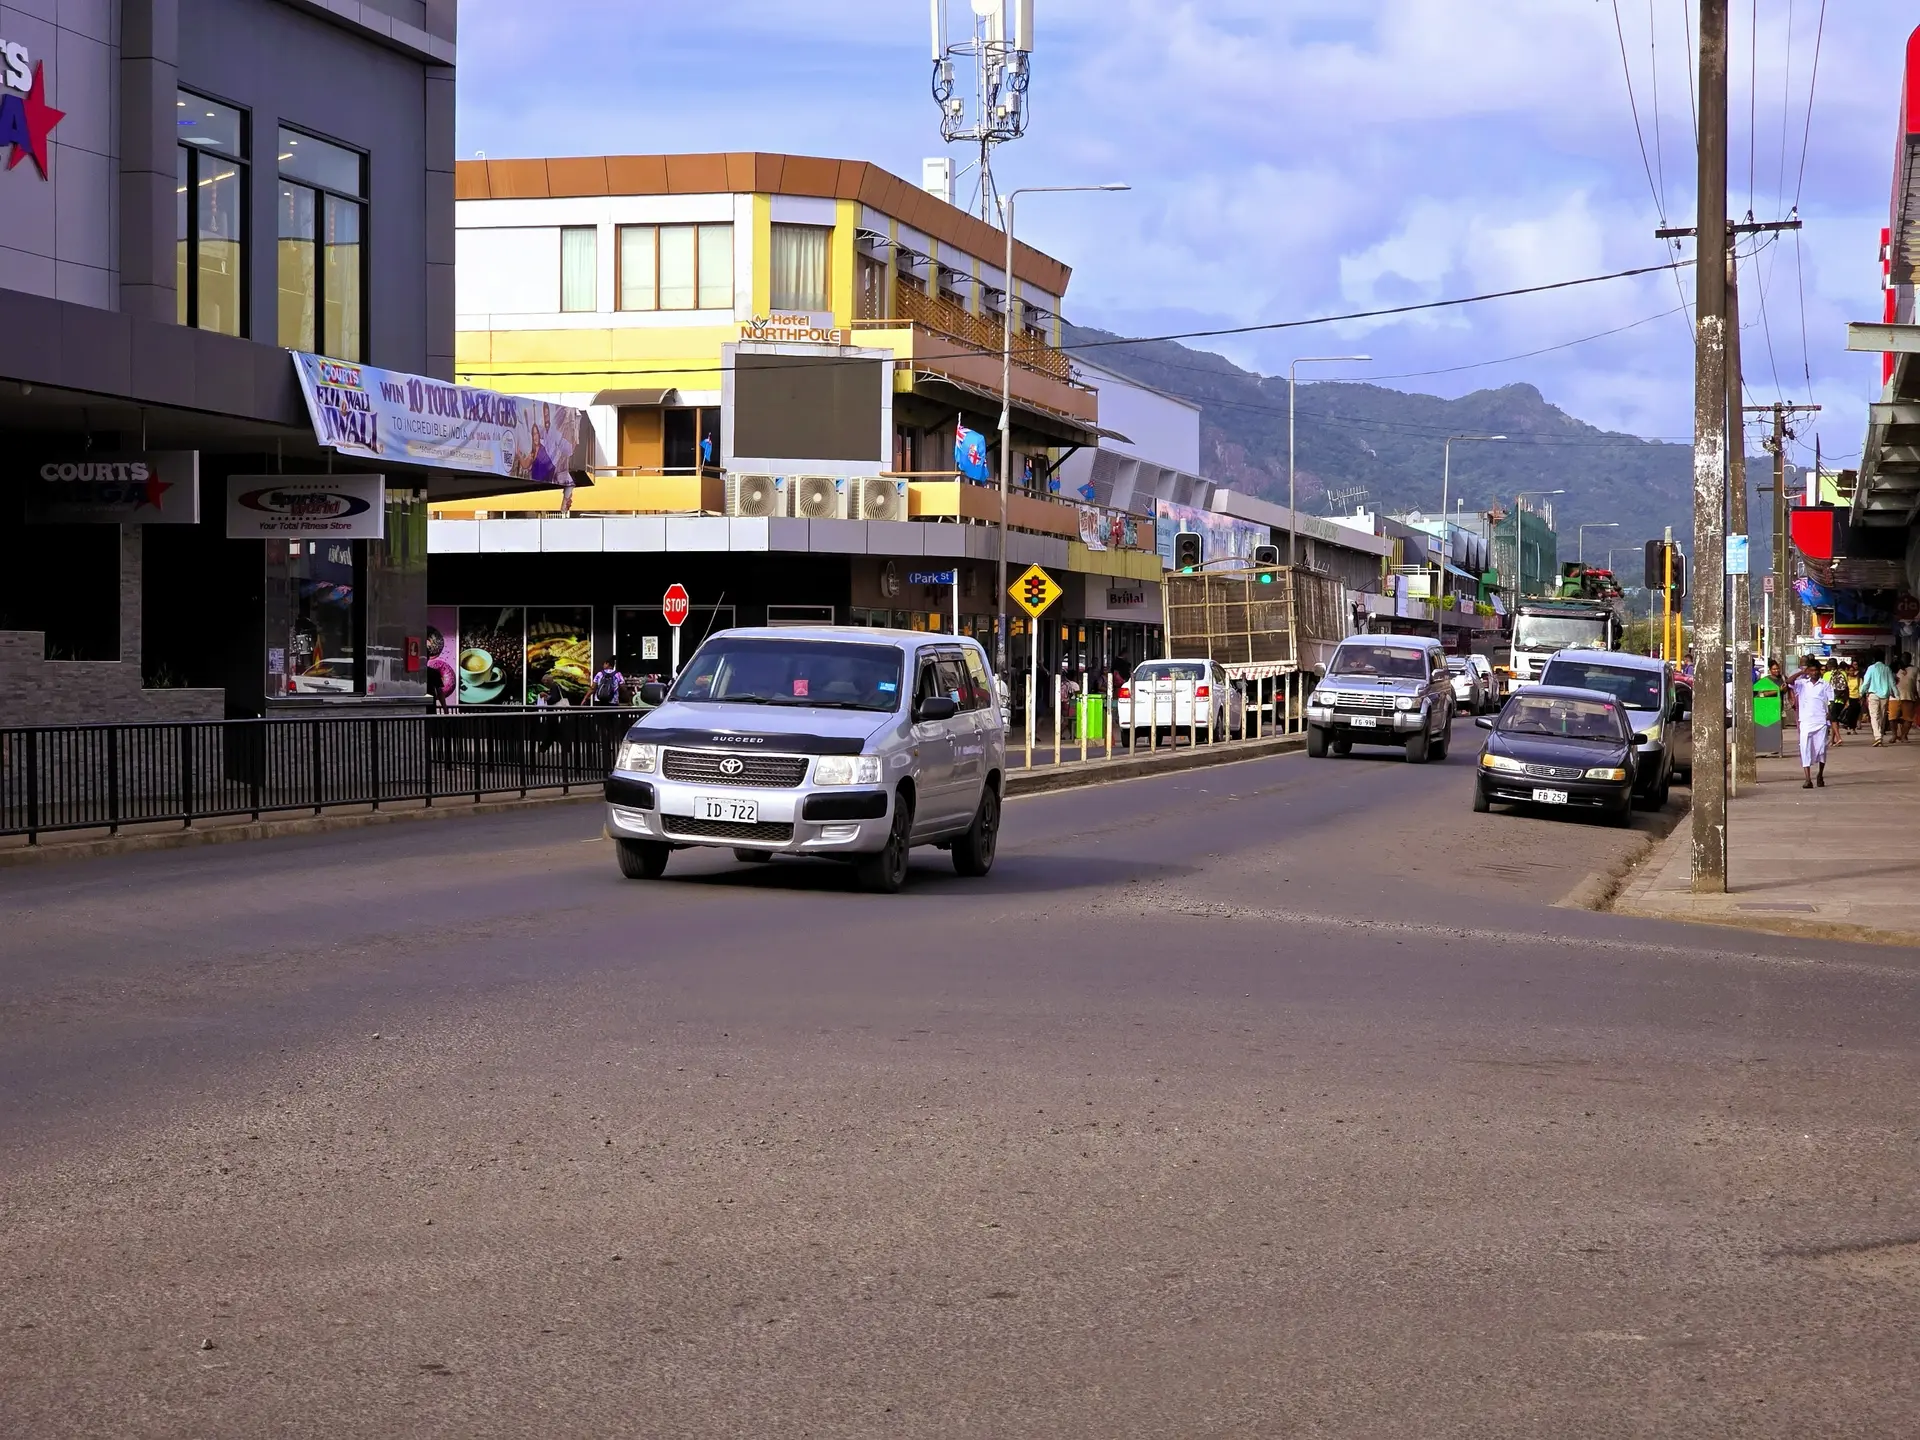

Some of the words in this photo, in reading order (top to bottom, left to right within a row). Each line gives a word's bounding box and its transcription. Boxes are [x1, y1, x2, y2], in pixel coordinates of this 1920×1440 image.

[771, 315, 810, 326] Hotel
[741, 326, 840, 342] NORTHPOLE
[322, 365, 360, 385] COURTS
[344, 390, 371, 412] WALI
[380, 382, 405, 404] WIN
[407, 378, 423, 414] 10
[425, 384, 460, 419] TOUR
[461, 390, 518, 429] PACKAGES
[392, 416, 403, 431] TO
[404, 418, 447, 438] INCREDIBLE
[448, 425, 468, 440] INDIA
[40, 462, 149, 482] COURTS
[269, 492, 328, 508] Sports
[290, 501, 341, 516] World
[259, 522, 277, 530] Your
[280, 522, 299, 530] Total
[301, 522, 329, 530] Fitness
[330, 522, 352, 530] Store
[914, 573, 939, 583] Park
[940, 572, 950, 580] St
[665, 598, 687, 612] STOP
[1538, 791, 1548, 801] FB
[1552, 793, 1567, 803] 252
